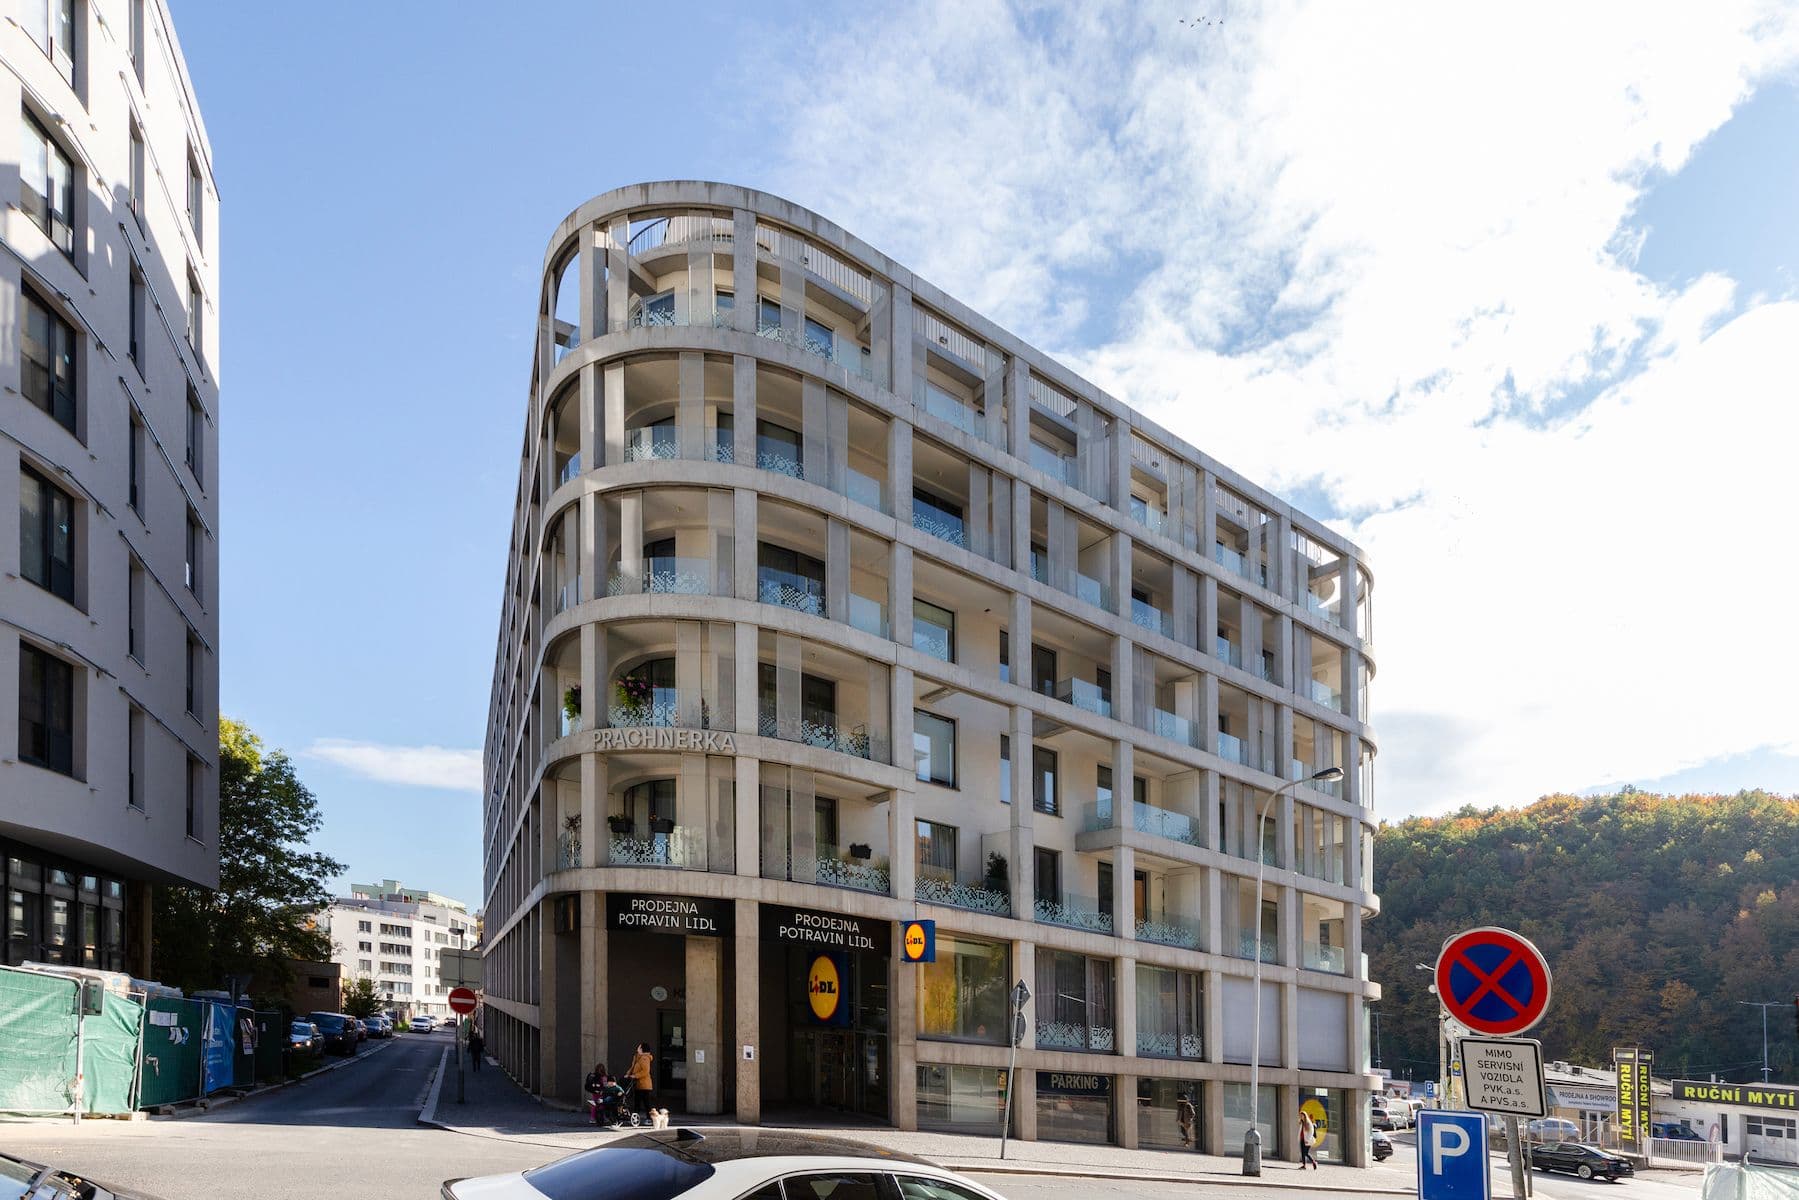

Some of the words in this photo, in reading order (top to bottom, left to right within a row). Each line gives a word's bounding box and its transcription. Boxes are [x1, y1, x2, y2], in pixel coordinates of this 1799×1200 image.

[593, 728, 737, 753] PRACHNERKA
[631, 899, 699, 914] PRODEJNA
[618, 913, 680, 928] POTRAVIN
[685, 917, 717, 931] LIDL
[795, 913, 860, 933] PRODEJNA
[779, 926, 844, 945] POTRAVIN
[848, 935, 875, 949] LIDL
[1485, 1048, 1512, 1059] MIMO
[1477, 1060, 1524, 1072] SERVISNÍ
[1051, 1074, 1099, 1090] PARKING
[1480, 1072, 1524, 1083] VOZIDLA
[1620, 1064, 1634, 1106] RUČNÍ
[1640, 1066, 1650, 1107] RUČNÍ
[1480, 1095, 1488, 1104] A
[1590, 1094, 1617, 1102] SHOWROO
[1684, 1084, 1741, 1102] RUČNÍ
[1748, 1091, 1795, 1107] MYTÍ
[1621, 1109, 1635, 1141] MYTÍ
[1641, 1110, 1650, 1137] MYT
[1432, 1122, 1471, 1176] P
